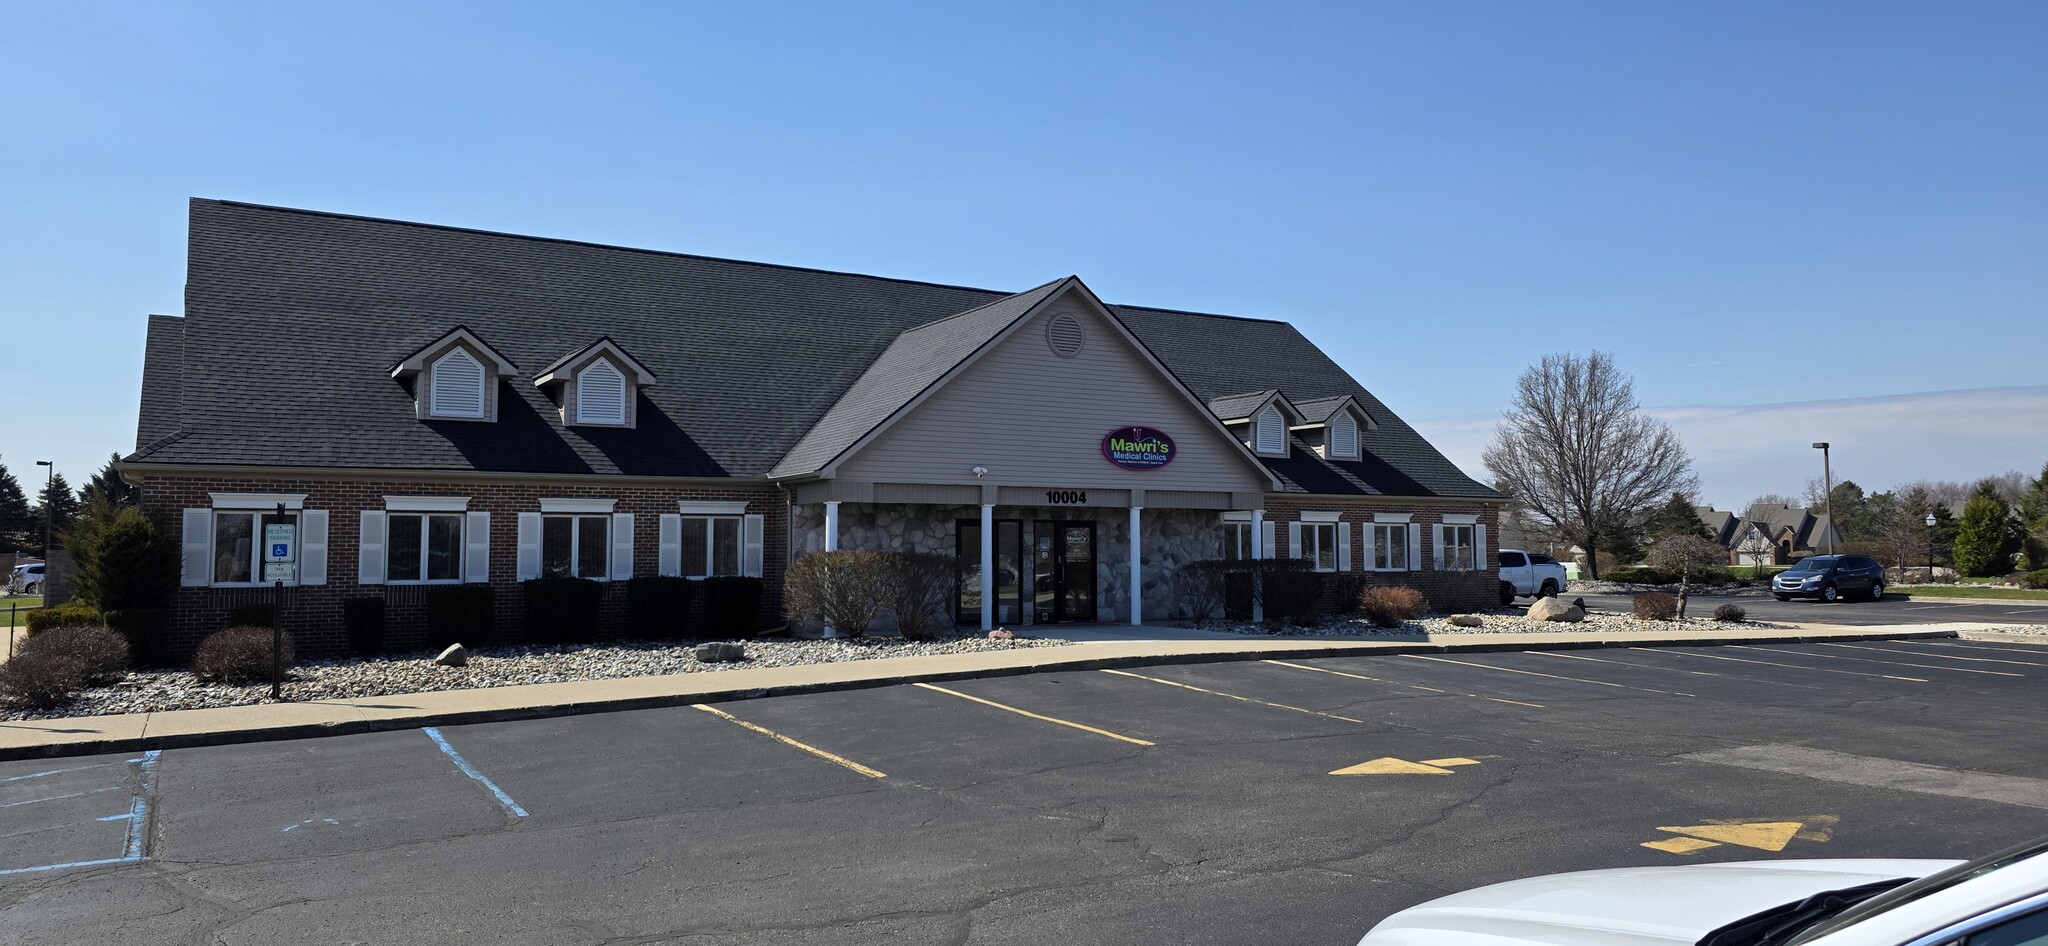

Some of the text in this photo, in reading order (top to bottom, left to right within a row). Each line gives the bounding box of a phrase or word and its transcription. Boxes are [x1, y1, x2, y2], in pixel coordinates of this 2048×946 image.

[1111, 438, 1169, 453] Mawri's
[1113, 451, 1167, 461] Medical Clinics
[1046, 490, 1087, 504] 10004
